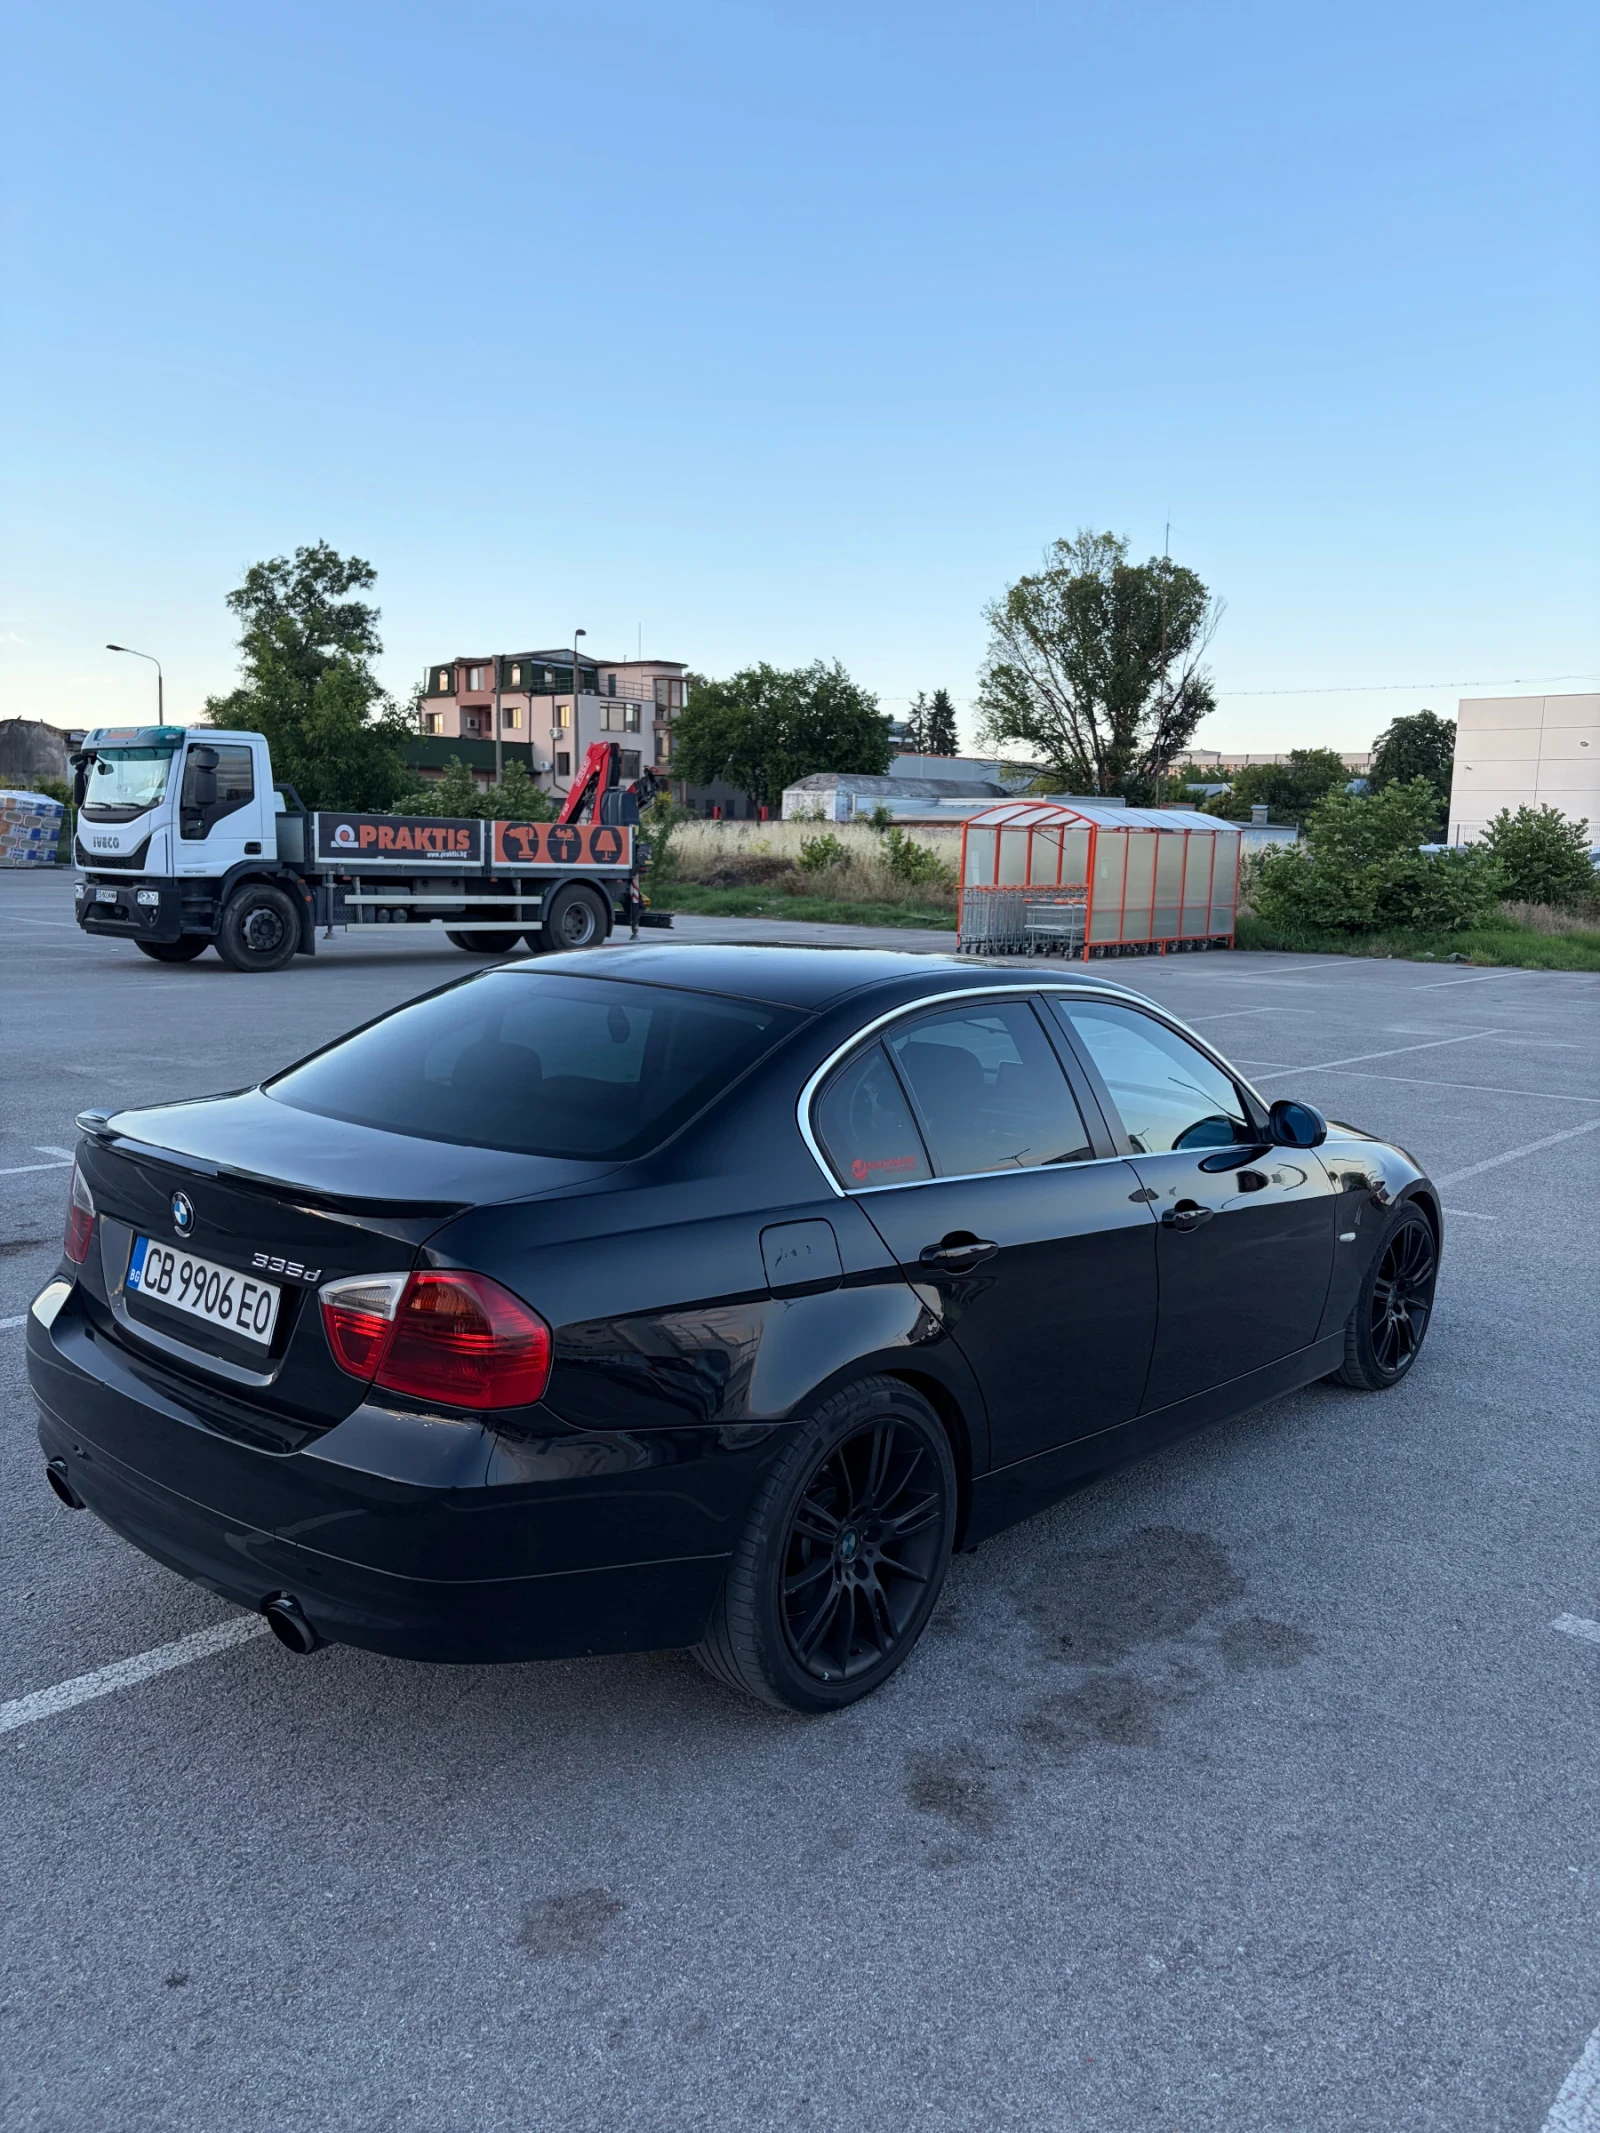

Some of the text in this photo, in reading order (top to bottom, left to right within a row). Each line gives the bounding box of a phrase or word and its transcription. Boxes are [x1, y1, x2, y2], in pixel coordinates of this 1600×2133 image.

[93, 836, 120, 849] IVECO
[359, 825, 470, 850] PRAKTIS
[426, 850, 468, 859] www.praktis.bg
[130, 1268, 141, 1282] BG
[251, 1252, 322, 1283] 335d
[144, 1248, 175, 1295] CB
[177, 1260, 235, 1320] 9906
